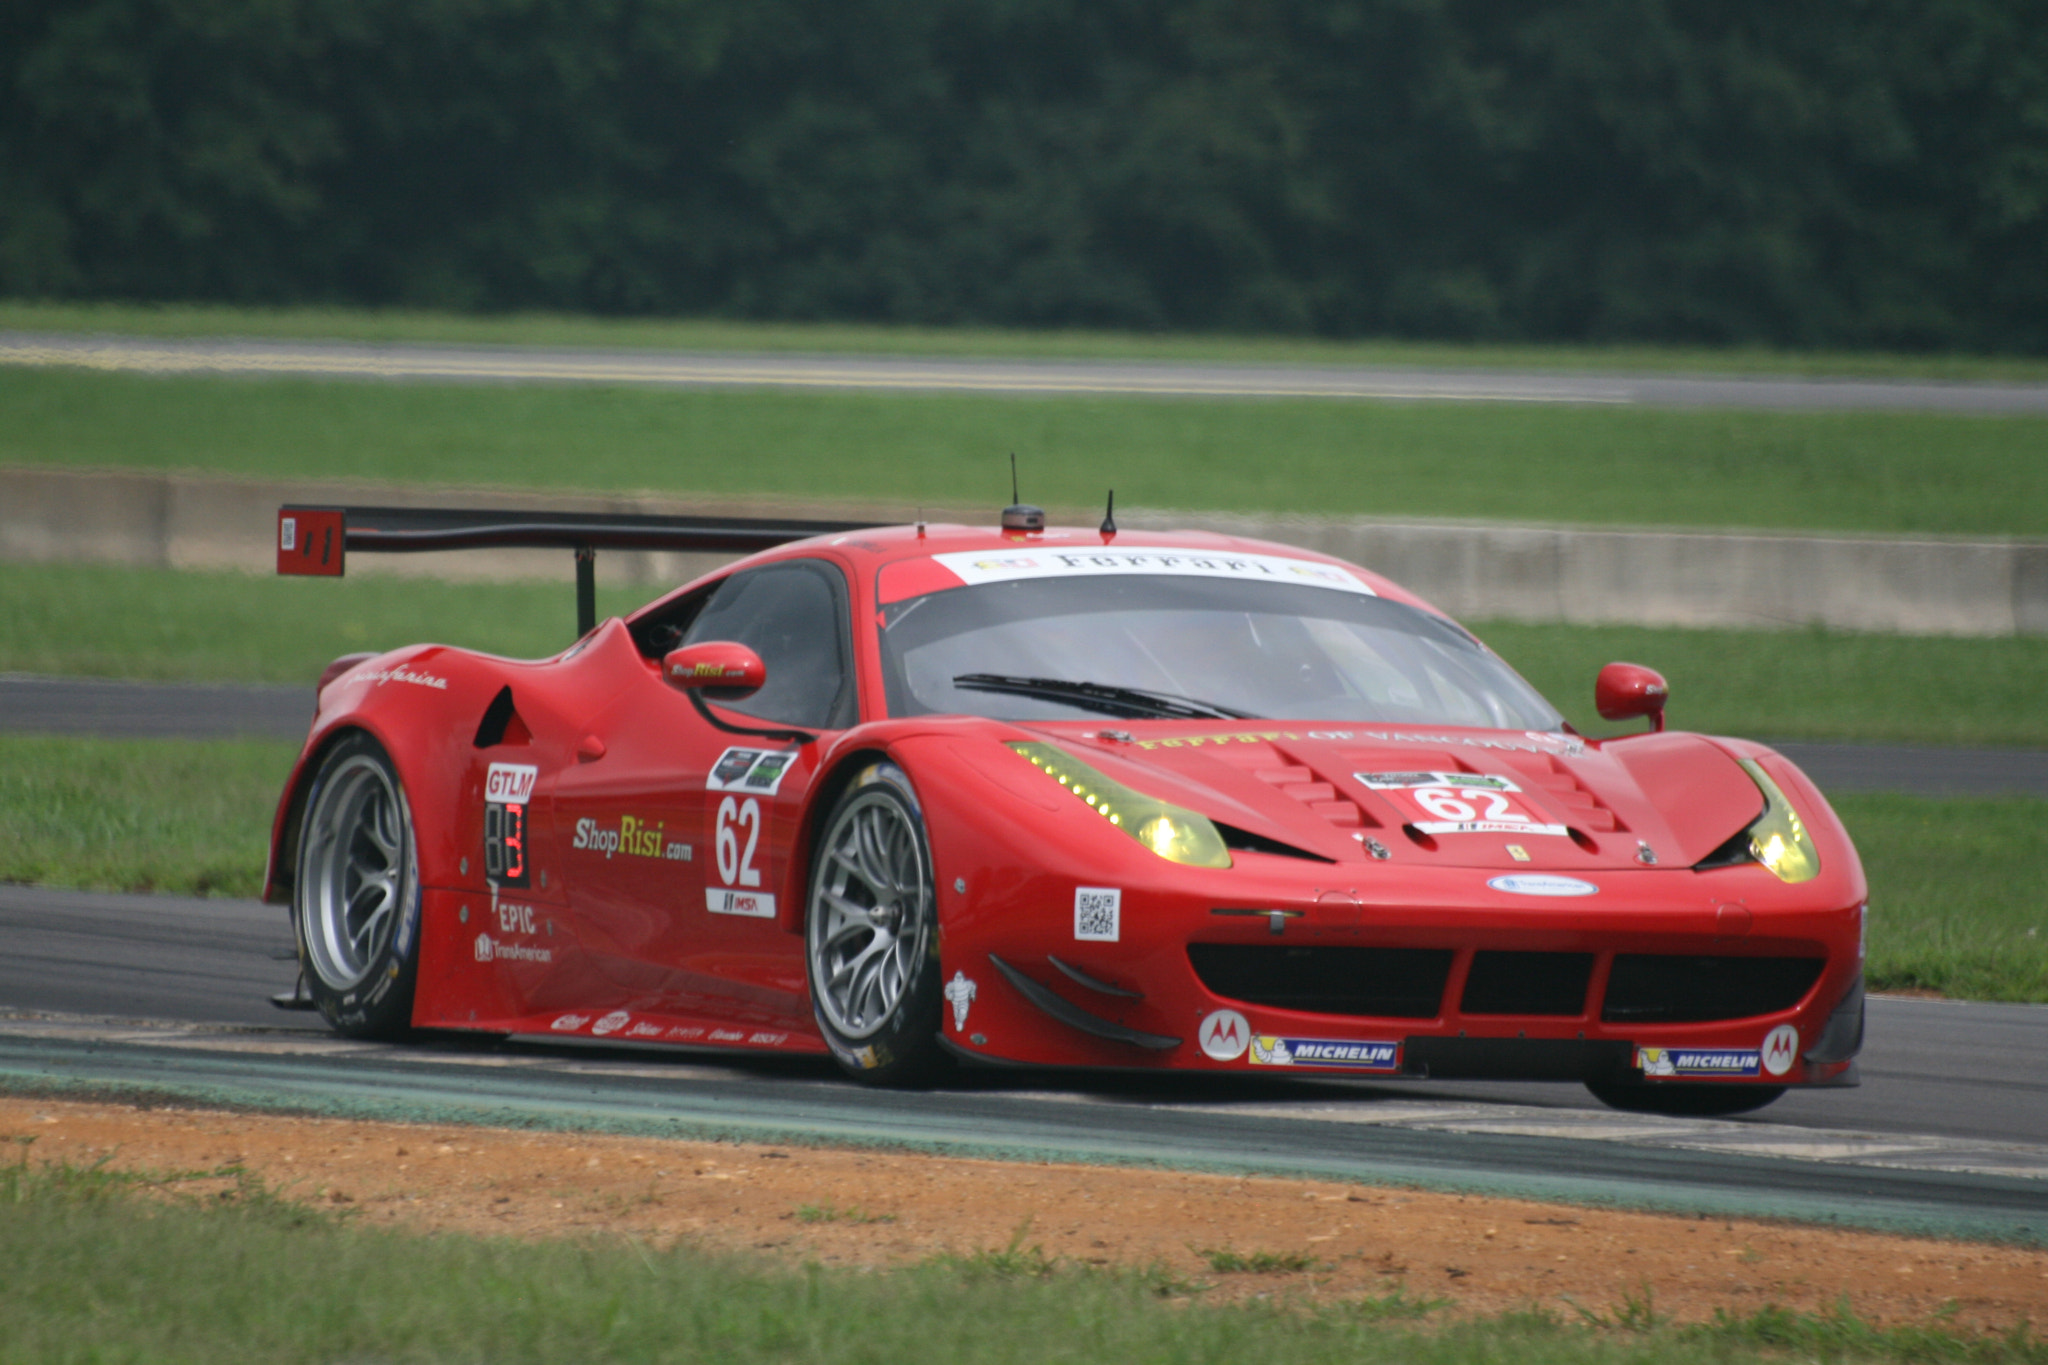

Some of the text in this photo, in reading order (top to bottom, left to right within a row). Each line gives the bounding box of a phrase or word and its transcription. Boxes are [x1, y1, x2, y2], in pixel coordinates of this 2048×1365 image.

[1052, 553, 1273, 575] Ferrari
[488, 770, 533, 797] GTLM
[1414, 788, 1530, 822] 62
[715, 795, 761, 887] 62
[734, 896, 759, 912] IMSA
[499, 903, 537, 934] EPIC
[1294, 1044, 1393, 1061] MICHELIN
[1677, 1055, 1758, 1068] MICHELIN
